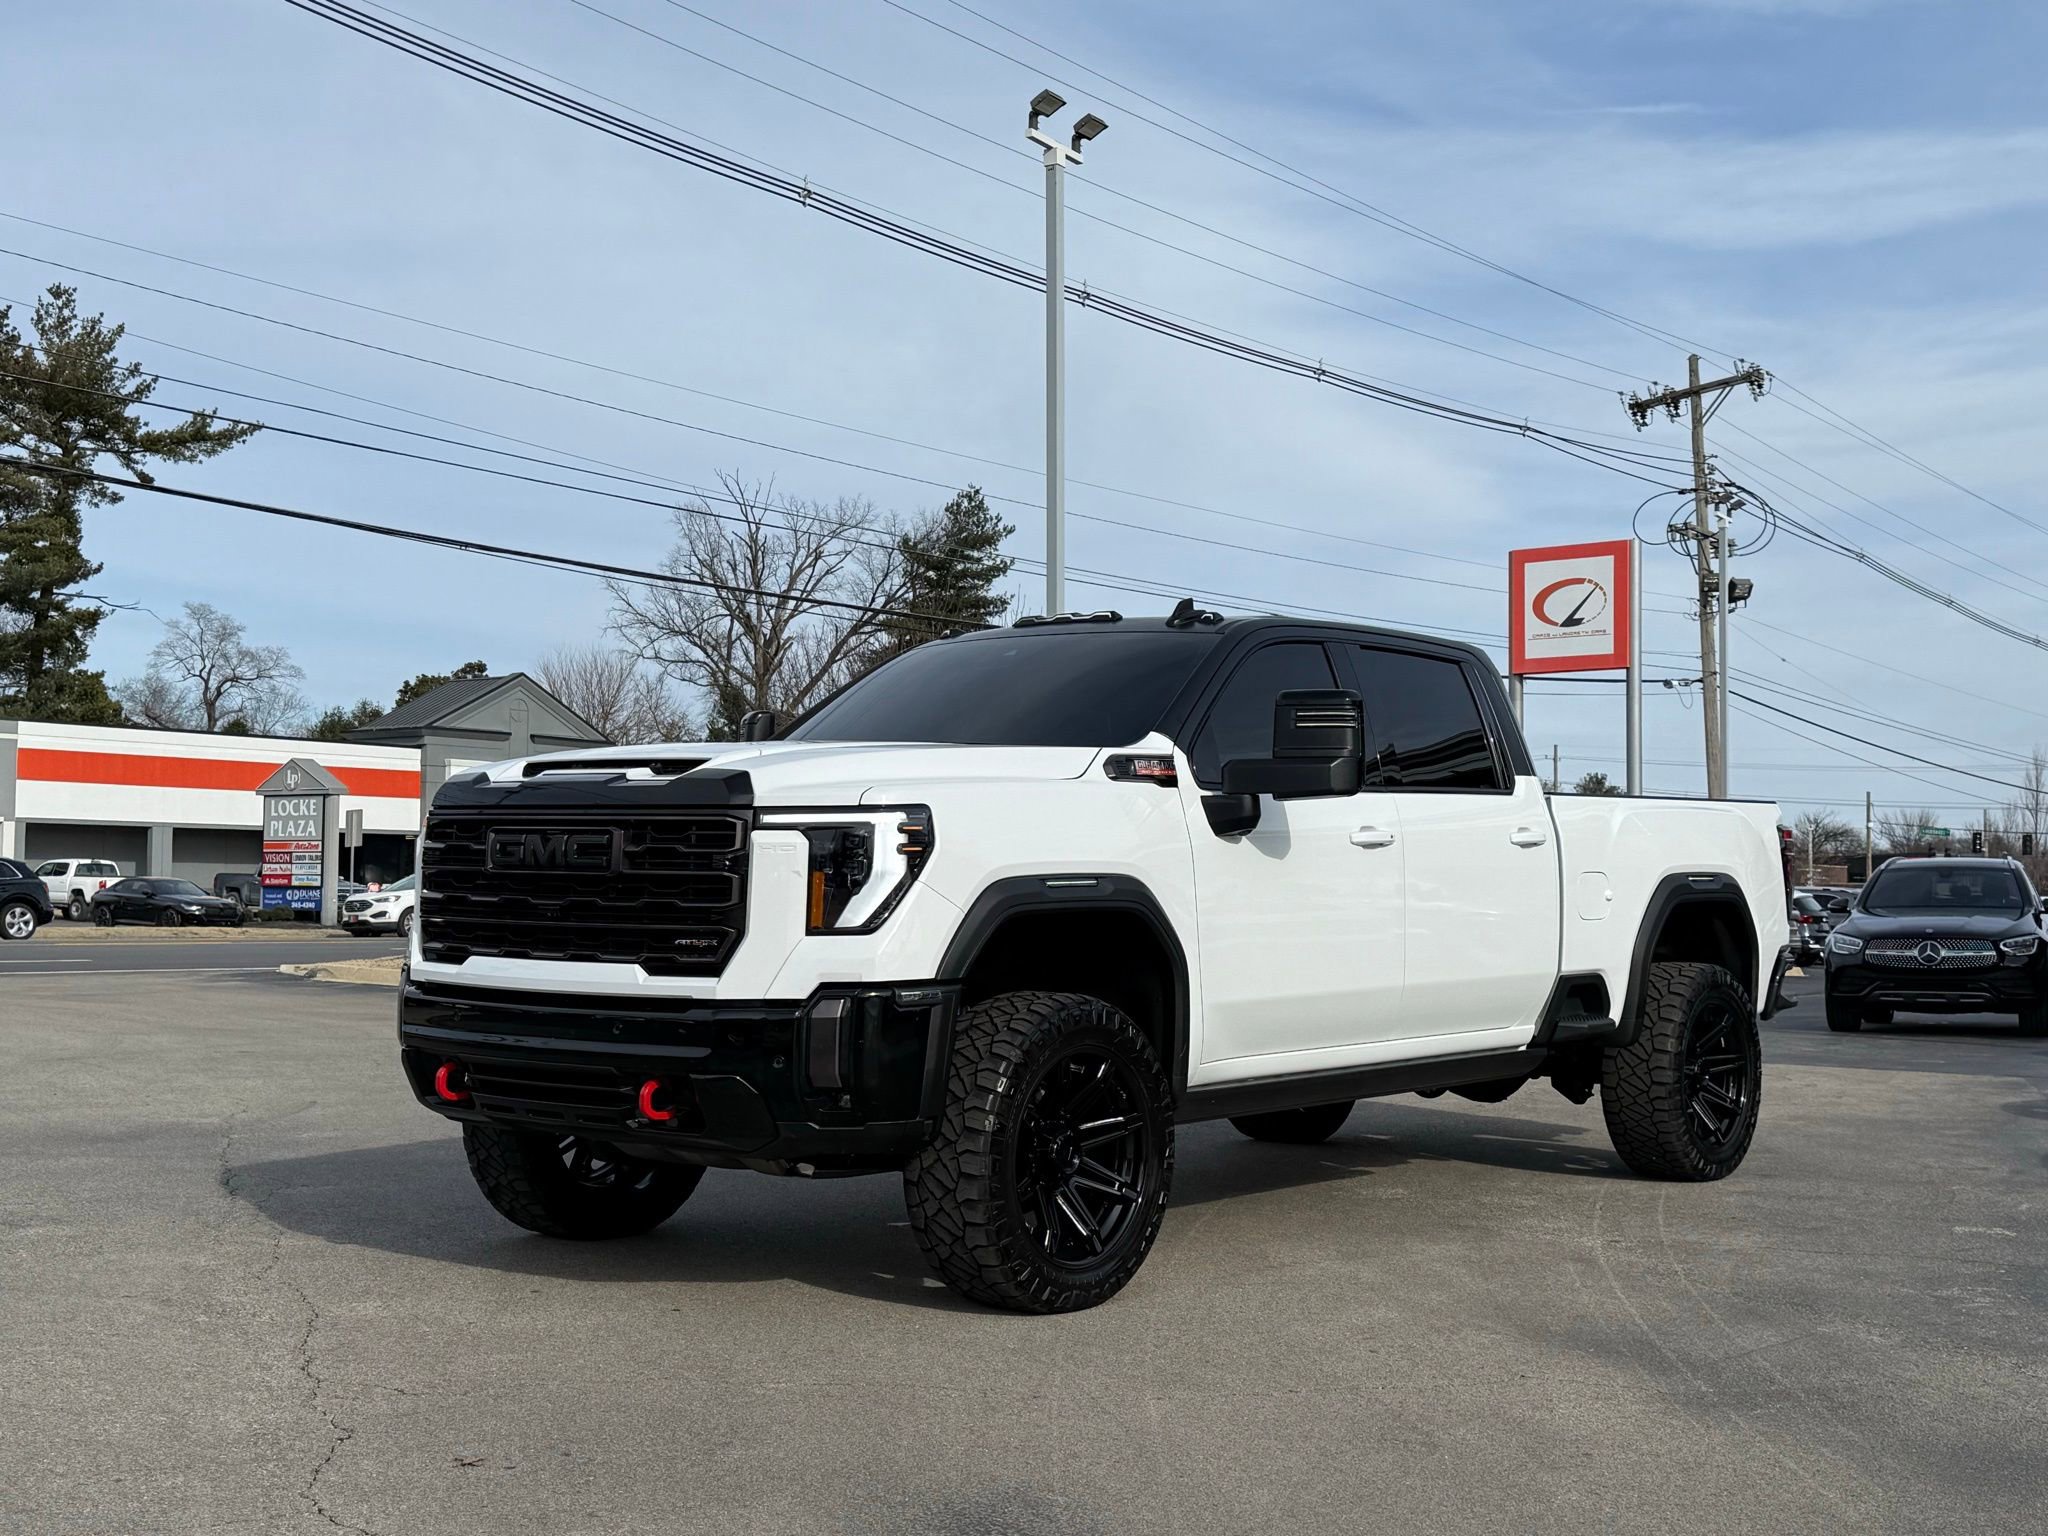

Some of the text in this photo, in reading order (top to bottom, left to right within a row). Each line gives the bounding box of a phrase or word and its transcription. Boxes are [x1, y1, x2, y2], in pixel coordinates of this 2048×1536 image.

[270, 799, 317, 817] LOCKE
[270, 819, 316, 837] PLAZA
[264, 853, 290, 863] VISION
[490, 834, 609, 866] GMC
